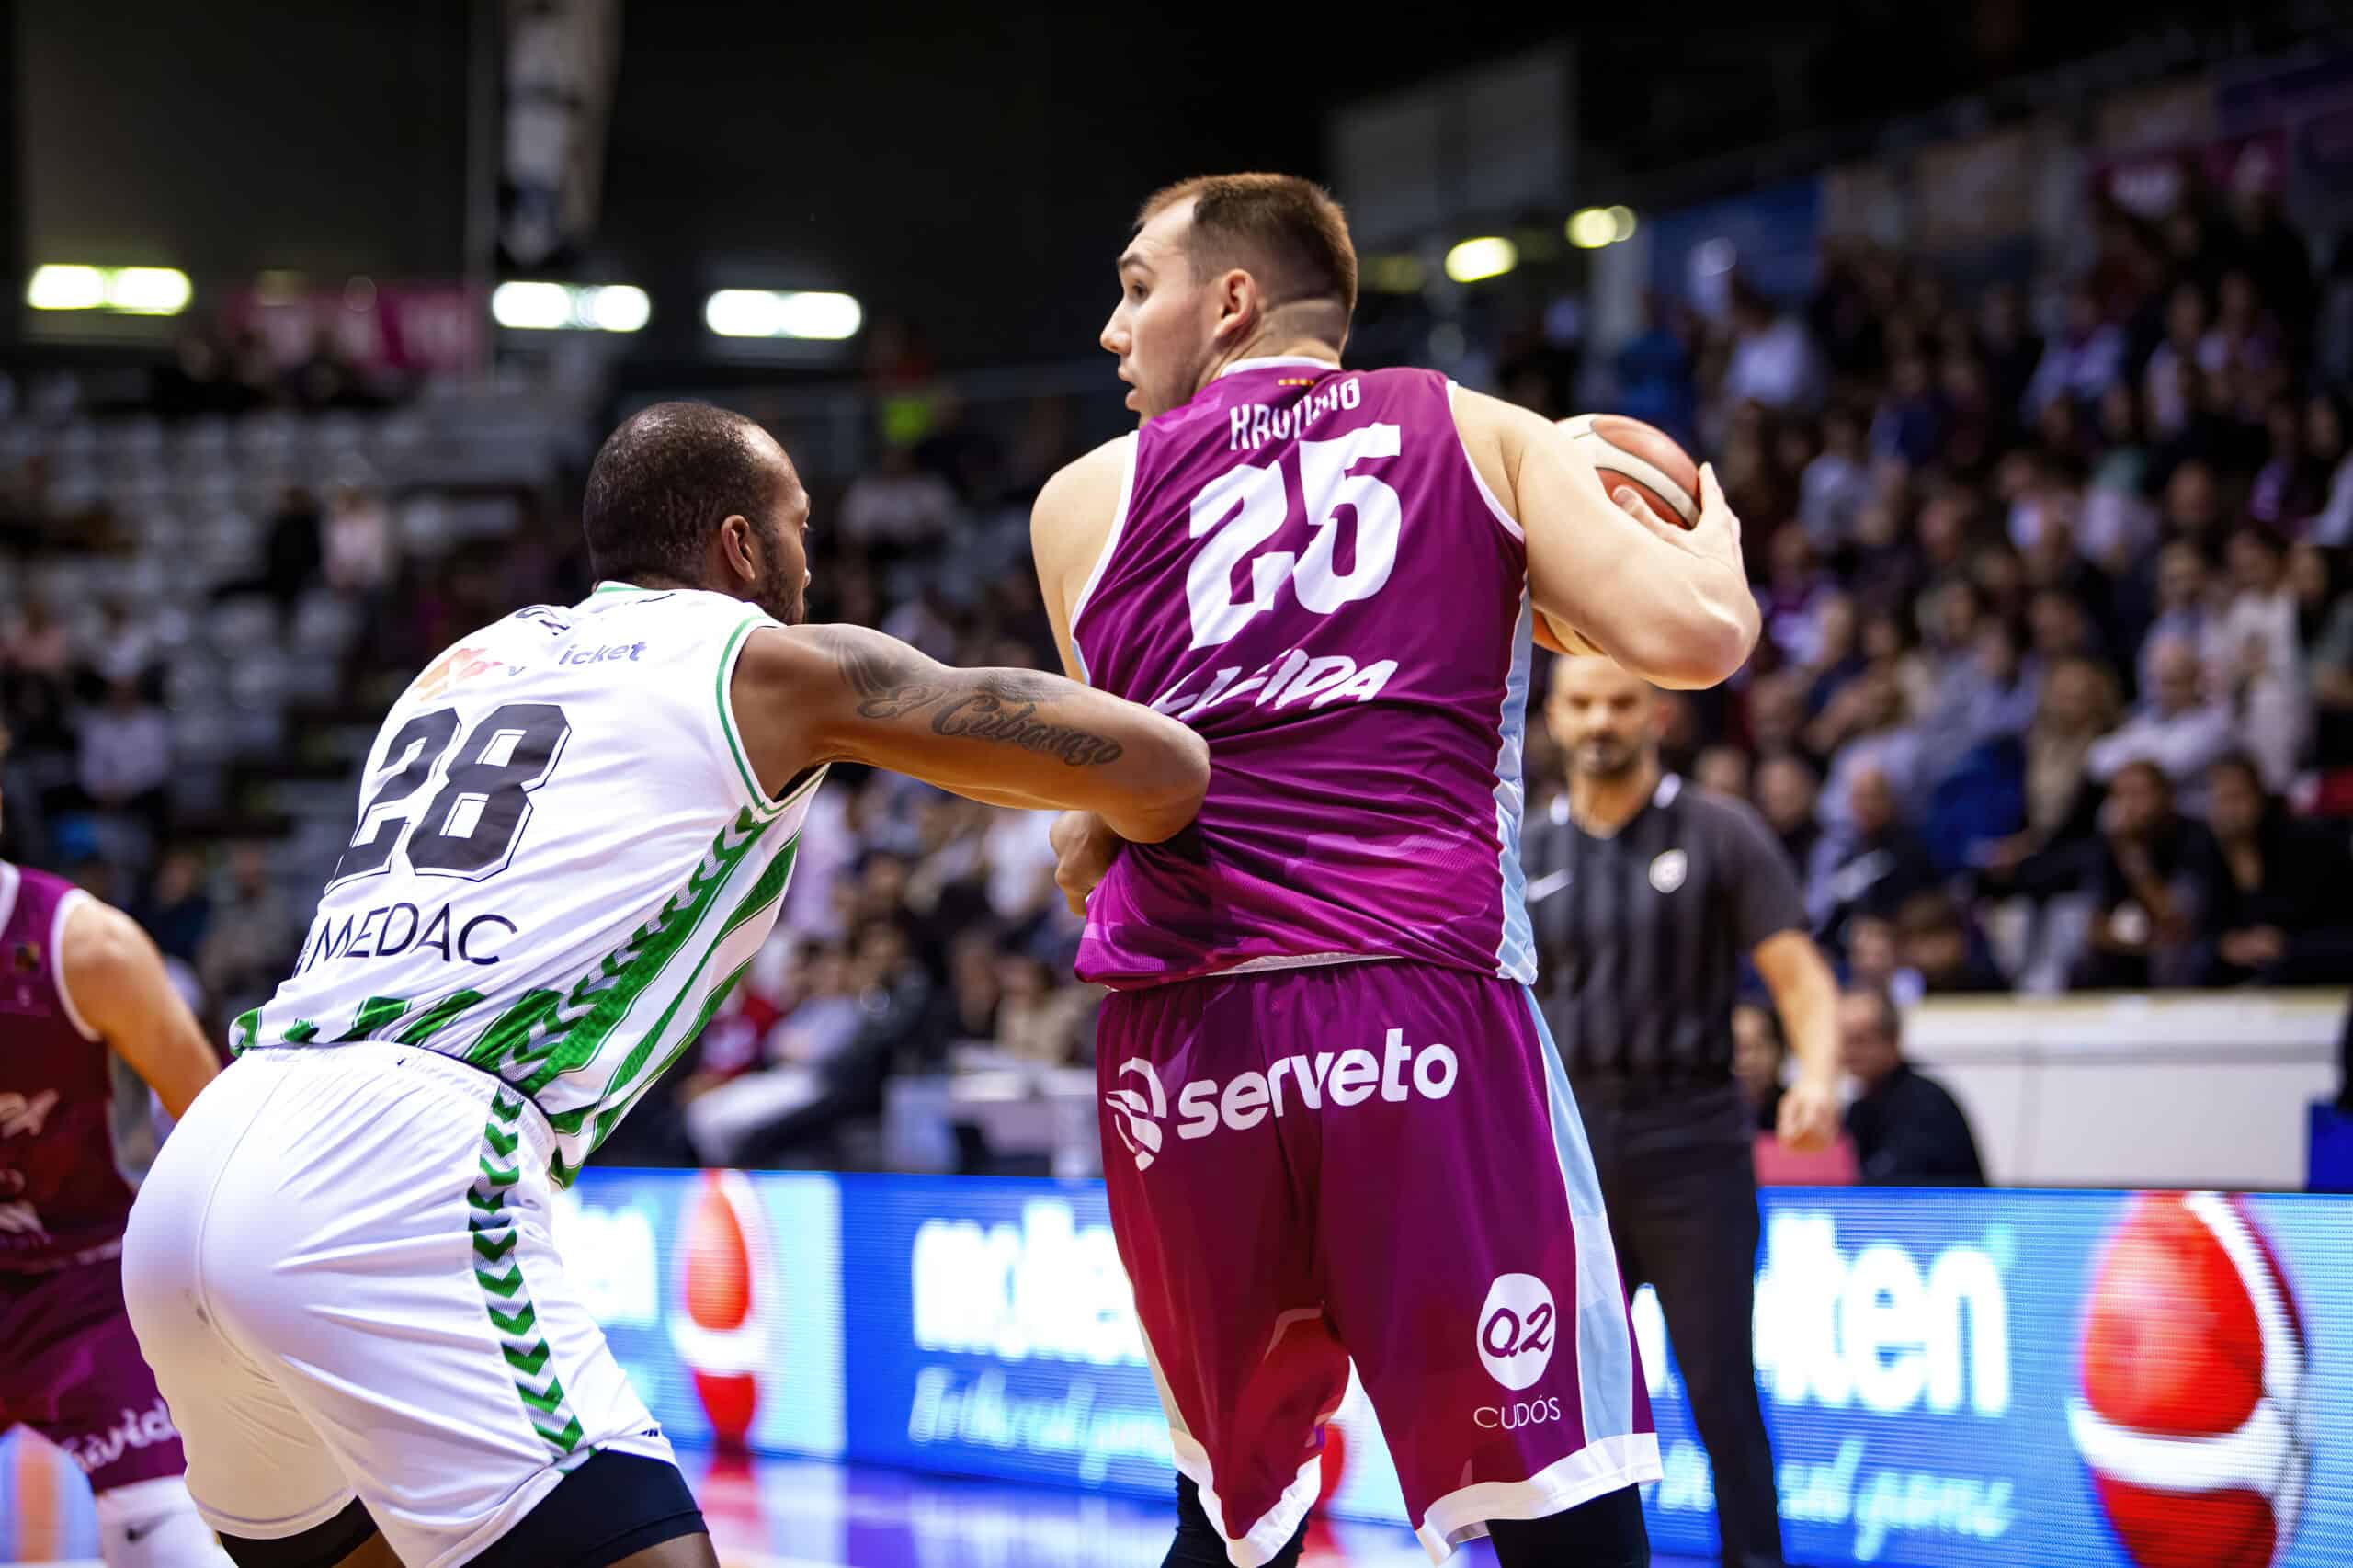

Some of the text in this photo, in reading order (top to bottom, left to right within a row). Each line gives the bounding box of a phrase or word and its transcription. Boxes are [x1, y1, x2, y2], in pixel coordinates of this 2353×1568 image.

[1186, 421, 1402, 652] 25
[324, 702, 573, 896] 28
[304, 902, 518, 966] MEDAC
[1176, 1028, 1459, 1141] serveto
[1482, 1302, 1552, 1359] Q2
[1473, 1394, 1562, 1430] CUDÓS
